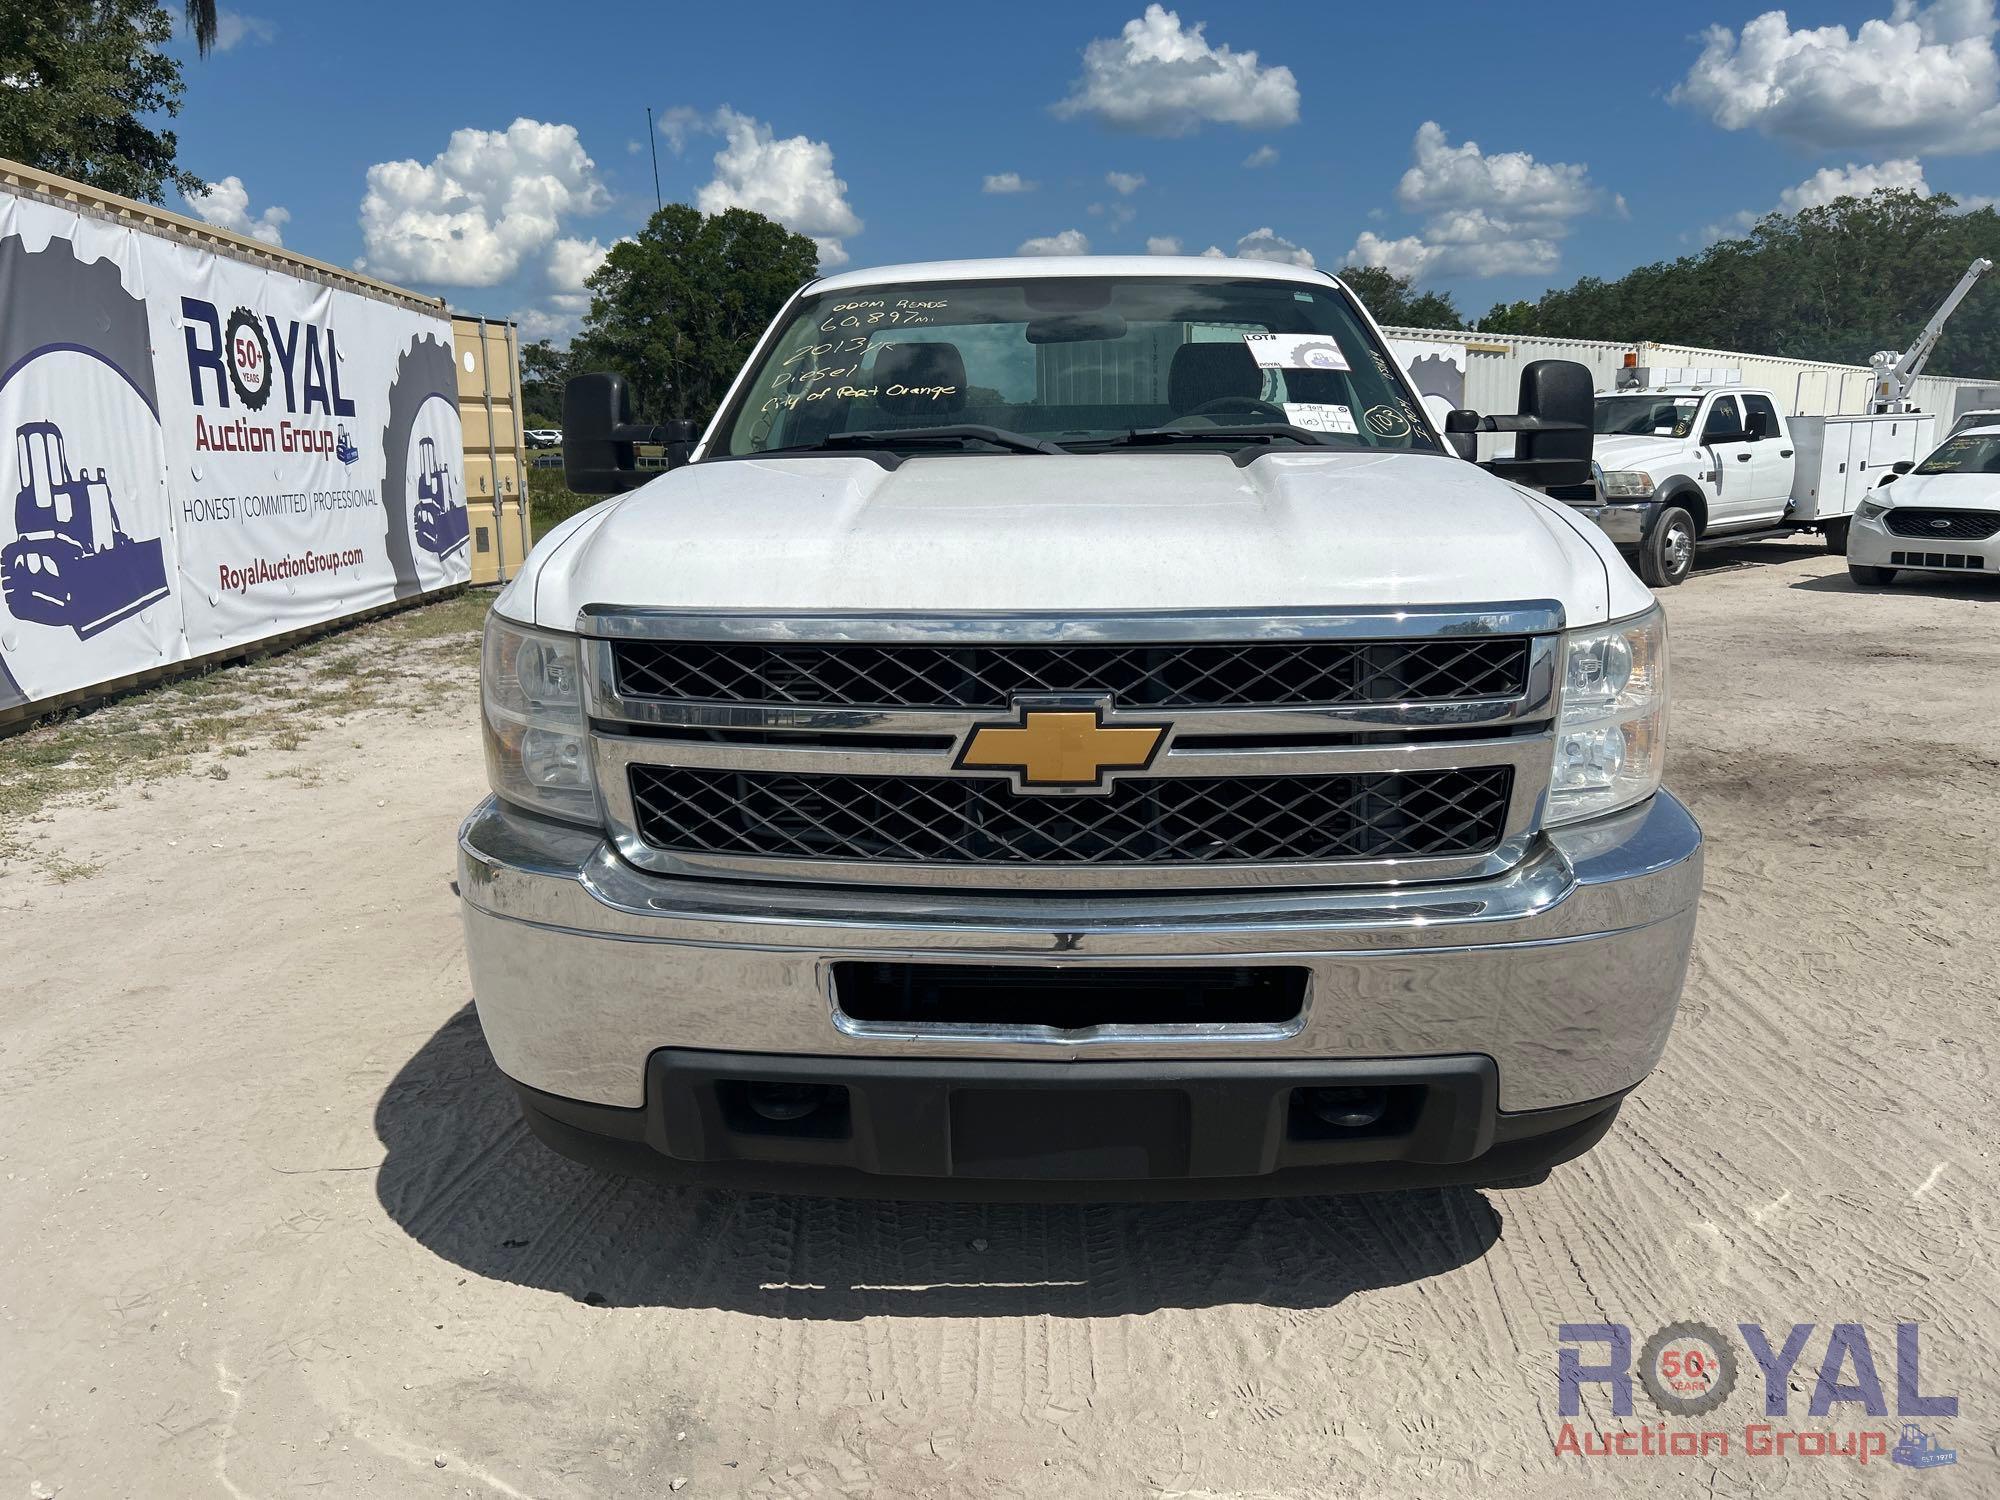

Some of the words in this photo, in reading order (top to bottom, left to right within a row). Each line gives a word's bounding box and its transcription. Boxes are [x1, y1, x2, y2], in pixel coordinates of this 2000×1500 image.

[833, 300, 885, 312] ODOM
[896, 300, 948, 309] READS
[181, 296, 356, 417] ROYAL
[236, 339, 262, 369] 50+
[242, 372, 260, 384] YEARS
[772, 364, 858, 389] Diesel
[761, 395, 800, 412] City
[807, 388, 831, 401] of
[886, 384, 956, 400] Orange
[196, 414, 276, 452] Auction
[280, 421, 335, 461] Group
[183, 497, 236, 522] HONEST
[245, 493, 308, 518] COMMITTED
[313, 488, 379, 511] PROFESSIONAL
[219, 548, 364, 595] RoyalAuctionGroup.com
